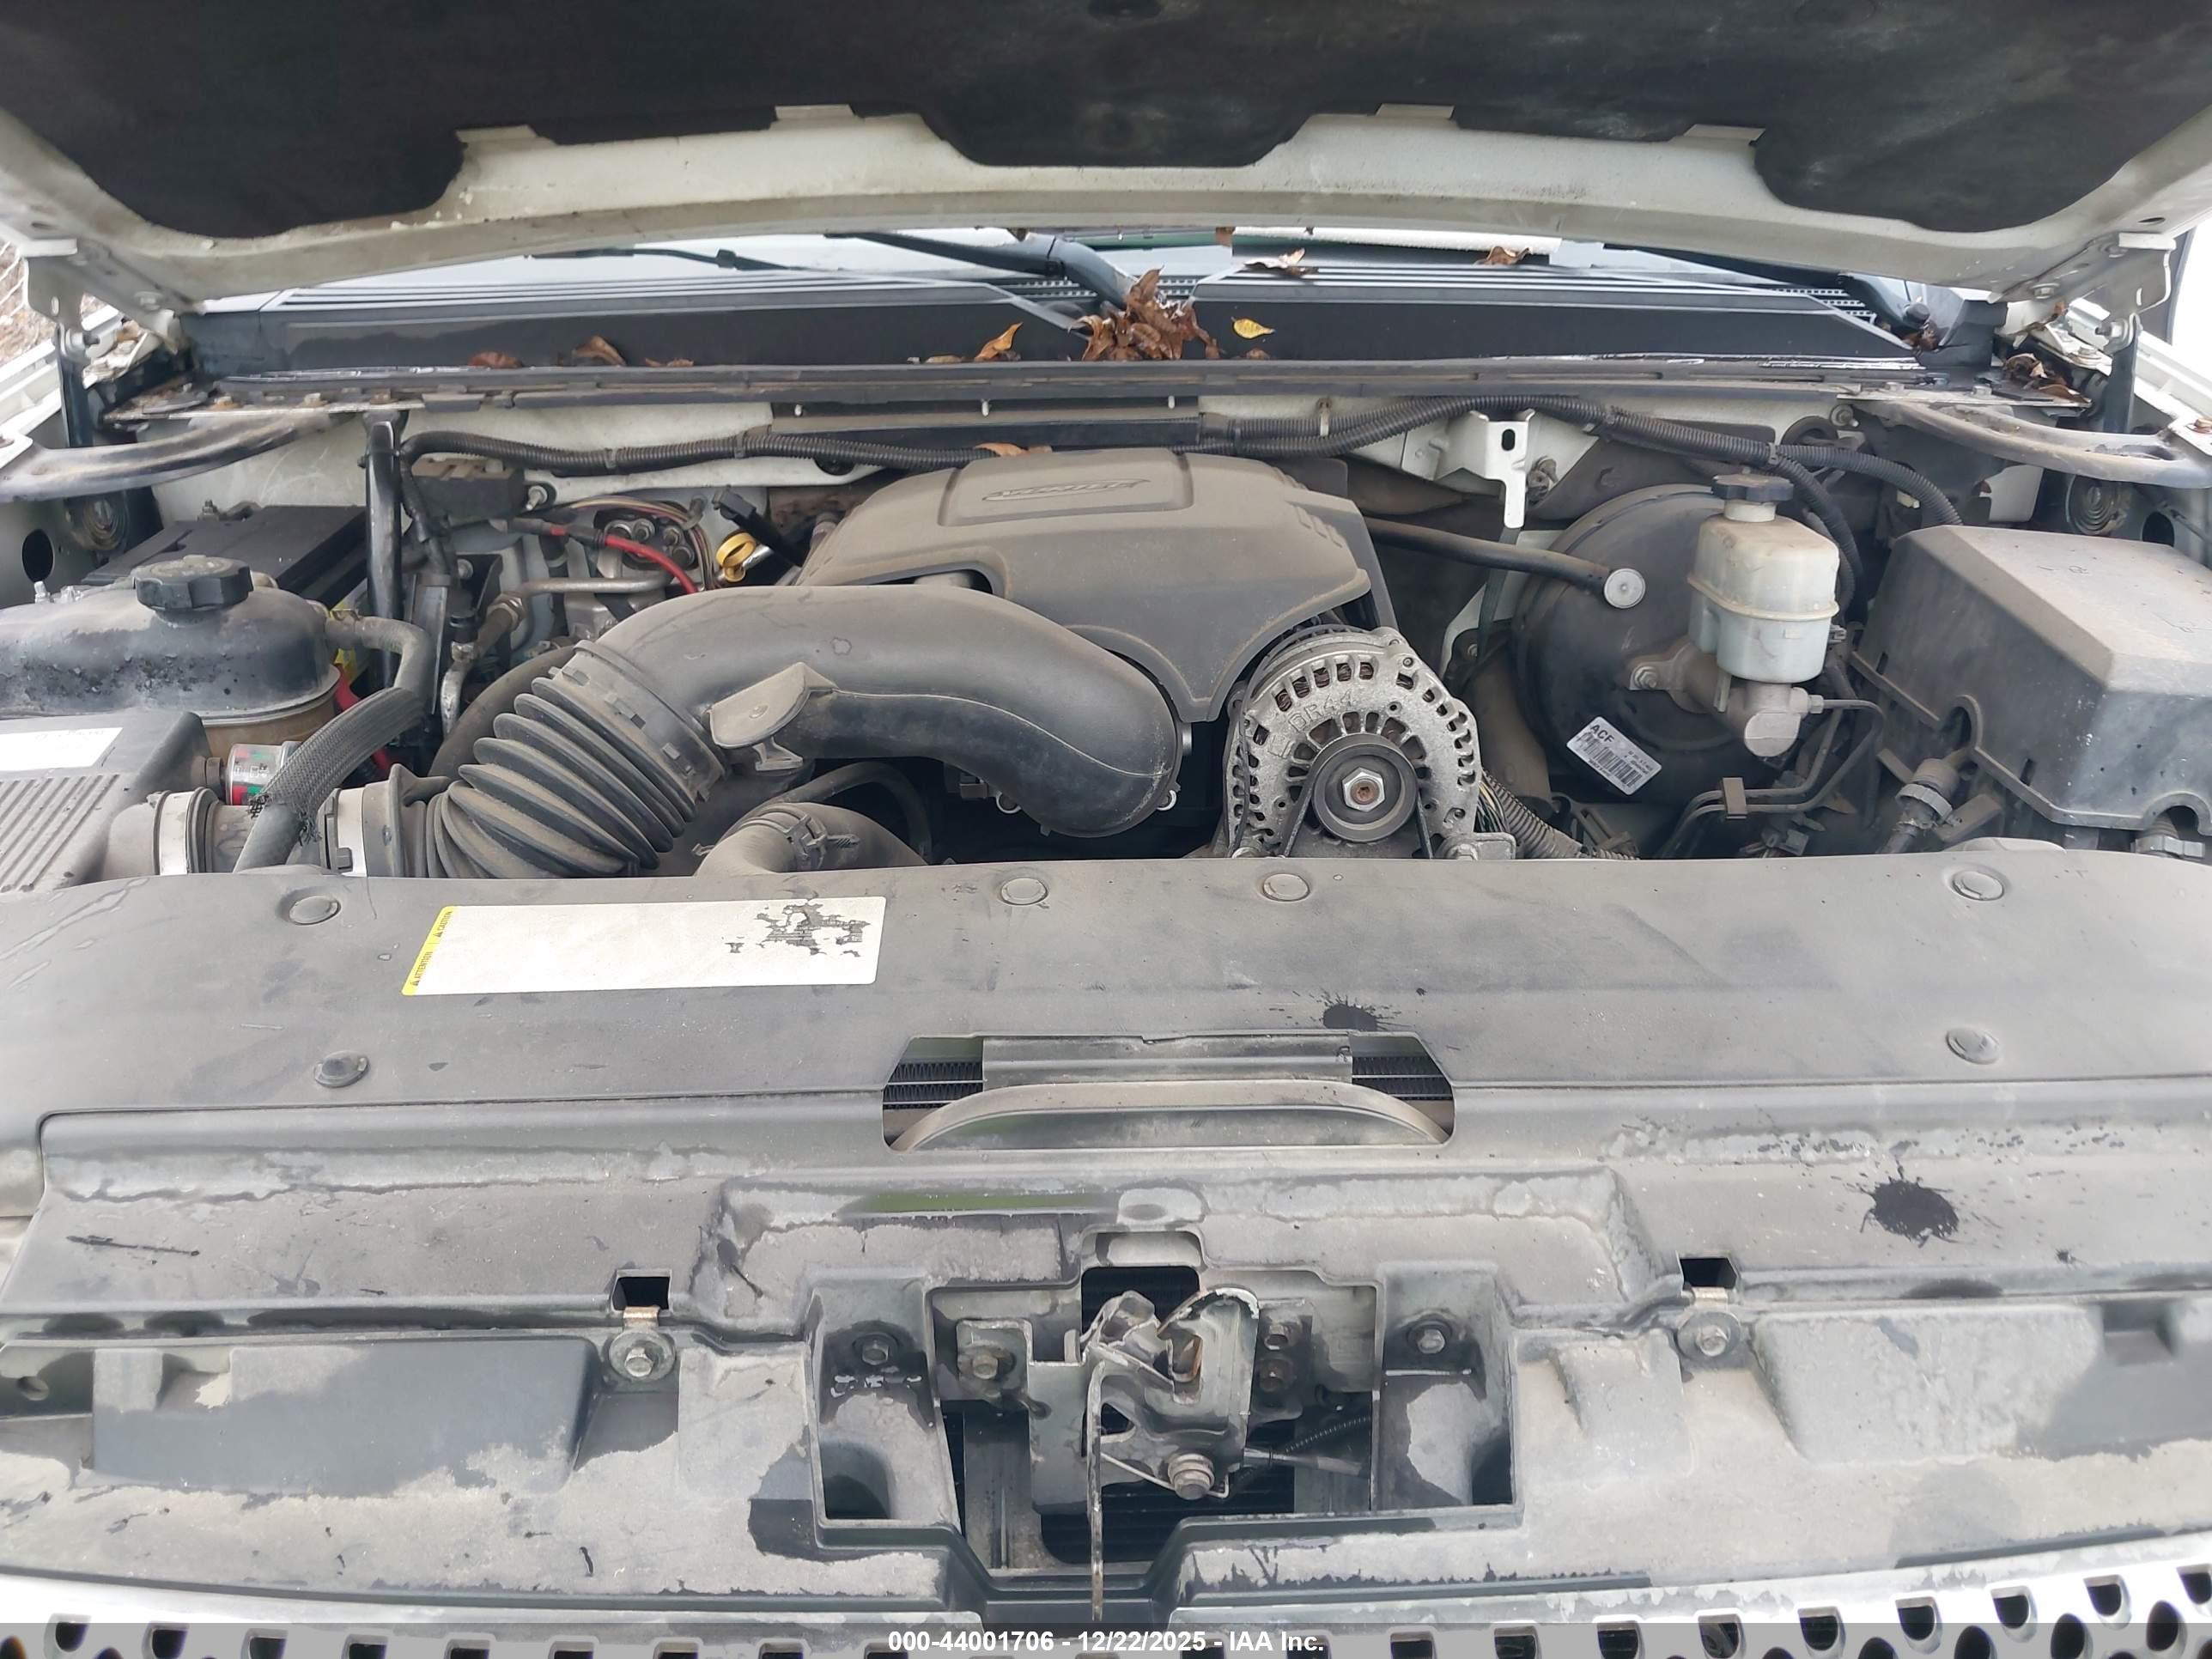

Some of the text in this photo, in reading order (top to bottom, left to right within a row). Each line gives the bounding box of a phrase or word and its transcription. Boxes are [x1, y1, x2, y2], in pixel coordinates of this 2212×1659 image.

[1590, 725, 1615, 743] ACF
[436, 911, 453, 932] CAUTION
[412, 951, 434, 978] ATTENTION
